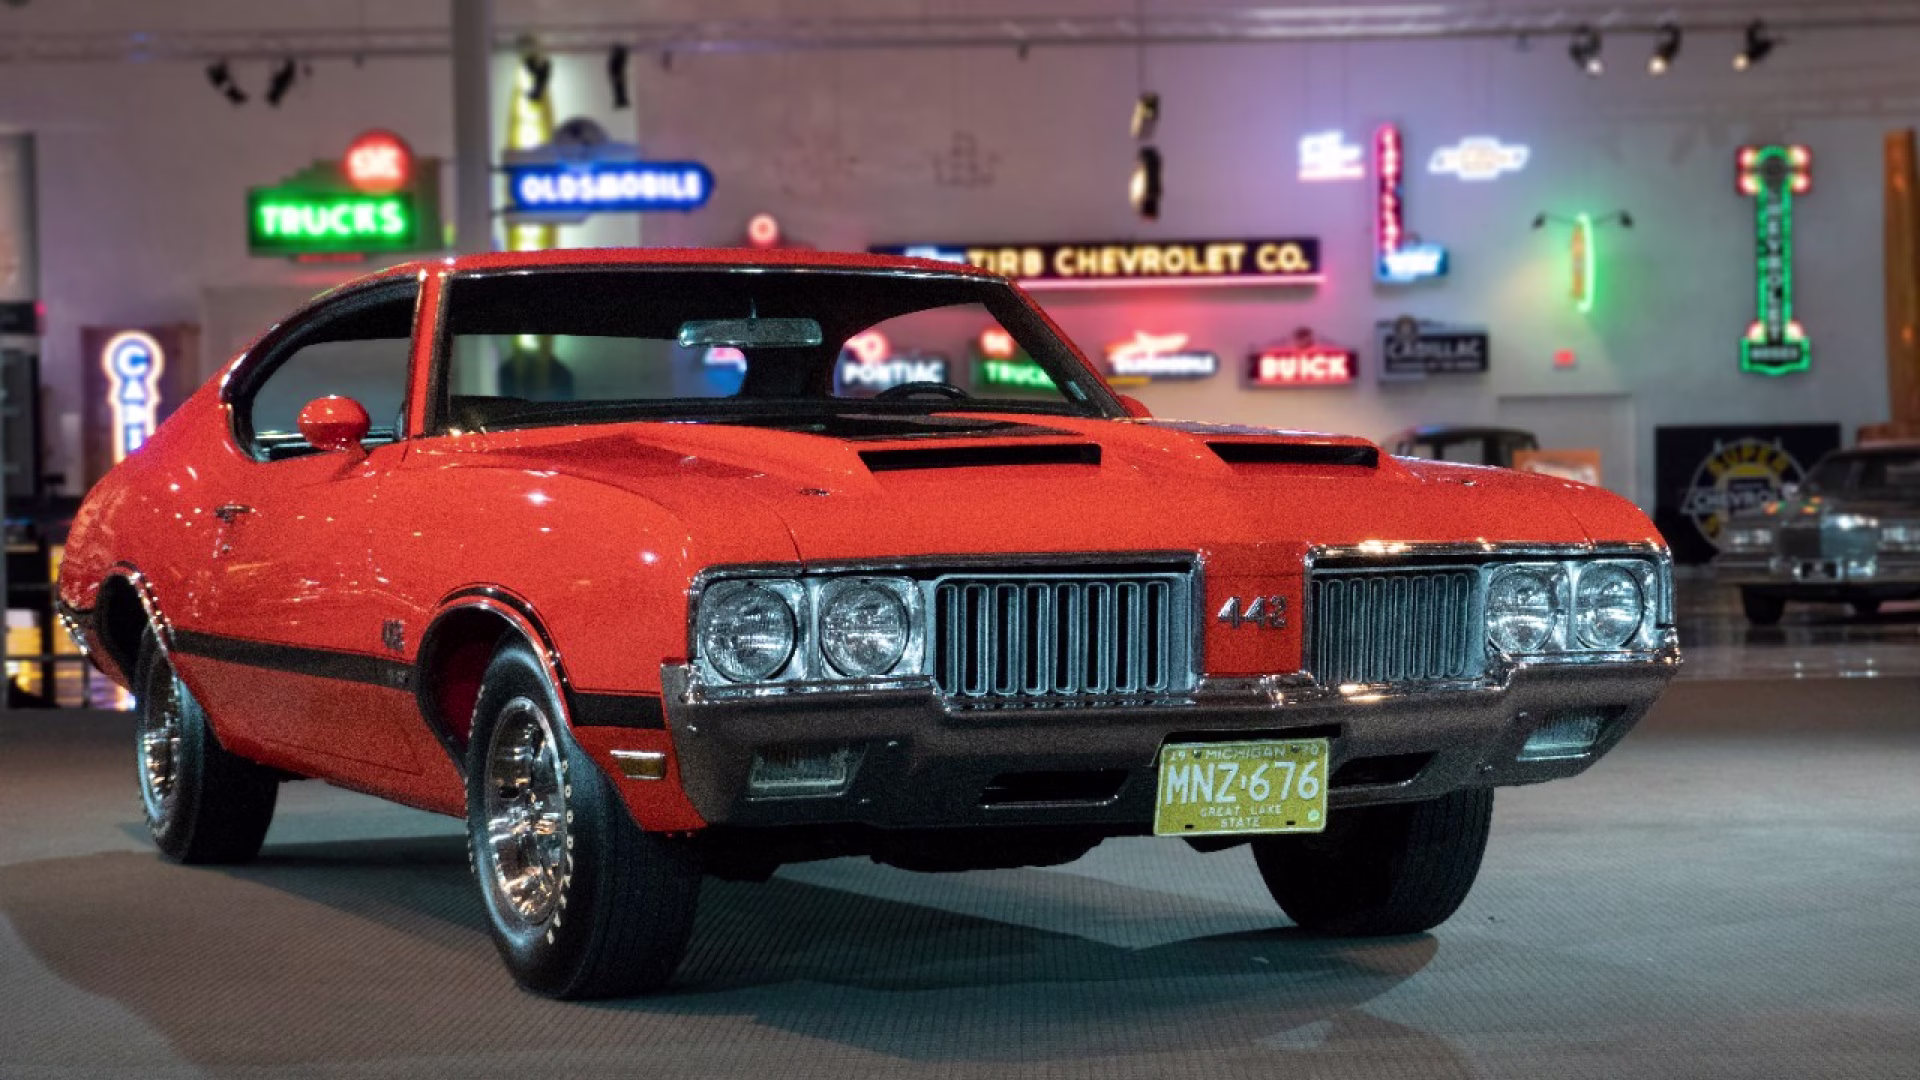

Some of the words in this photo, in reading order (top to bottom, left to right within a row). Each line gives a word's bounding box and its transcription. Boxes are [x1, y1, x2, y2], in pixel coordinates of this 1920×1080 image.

[521, 172, 701, 203] OLDSMOBILE
[260, 202, 404, 236] TRUCKS
[1056, 246, 1245, 275] CHEVROLET
[1257, 245, 1309, 271] CO.
[843, 361, 943, 384] PONTIAC
[1260, 356, 1348, 379] BUICK
[1706, 442, 1788, 474] SUPER
[1217, 595, 1286, 629] 442
[1205, 747, 1286, 760] MICHIGAN
[1201, 806, 1241, 817] GREAT
[1250, 803, 1283, 815] LAKE
[1220, 816, 1261, 829] STATE
